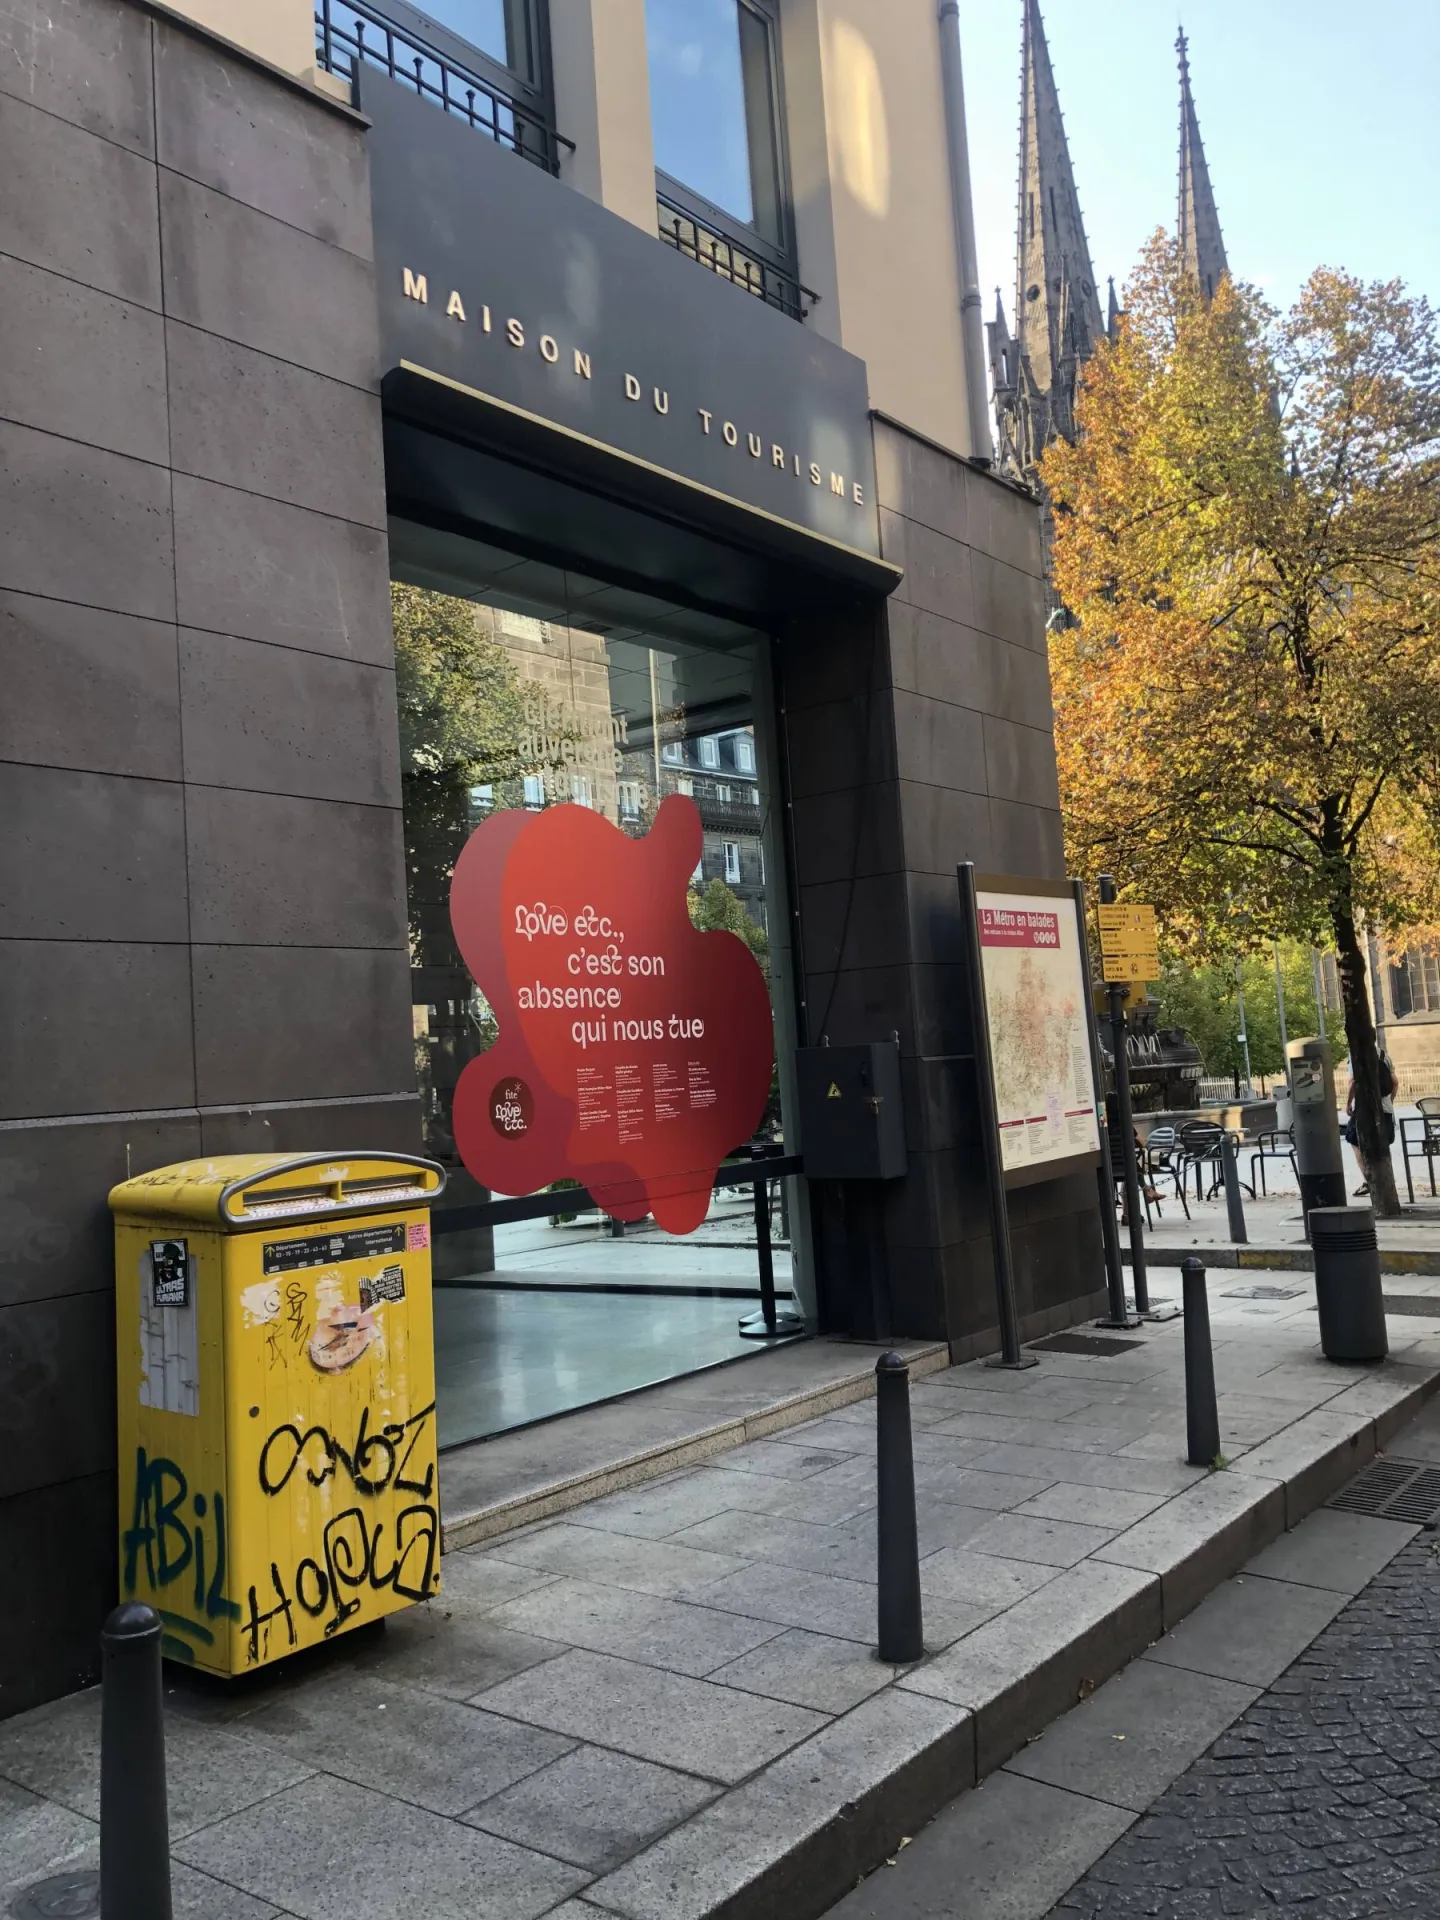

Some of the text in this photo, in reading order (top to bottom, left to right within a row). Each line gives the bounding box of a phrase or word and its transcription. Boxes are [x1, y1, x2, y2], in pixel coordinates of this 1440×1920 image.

[402, 267, 864, 506] MAISON DU TOURISME
[515, 902, 625, 943] Love etc.,
[982, 910, 1055, 928] La Métro en balades
[567, 944, 665, 976] c’est son
[518, 980, 621, 1009] absence
[571, 1013, 705, 1049] qui nous tue
[495, 1101, 522, 1121] Love
[363, 1229, 393, 1238] départements
[275, 1242, 307, 1251] Départements
[156, 1277, 185, 1294] ULTRAS
